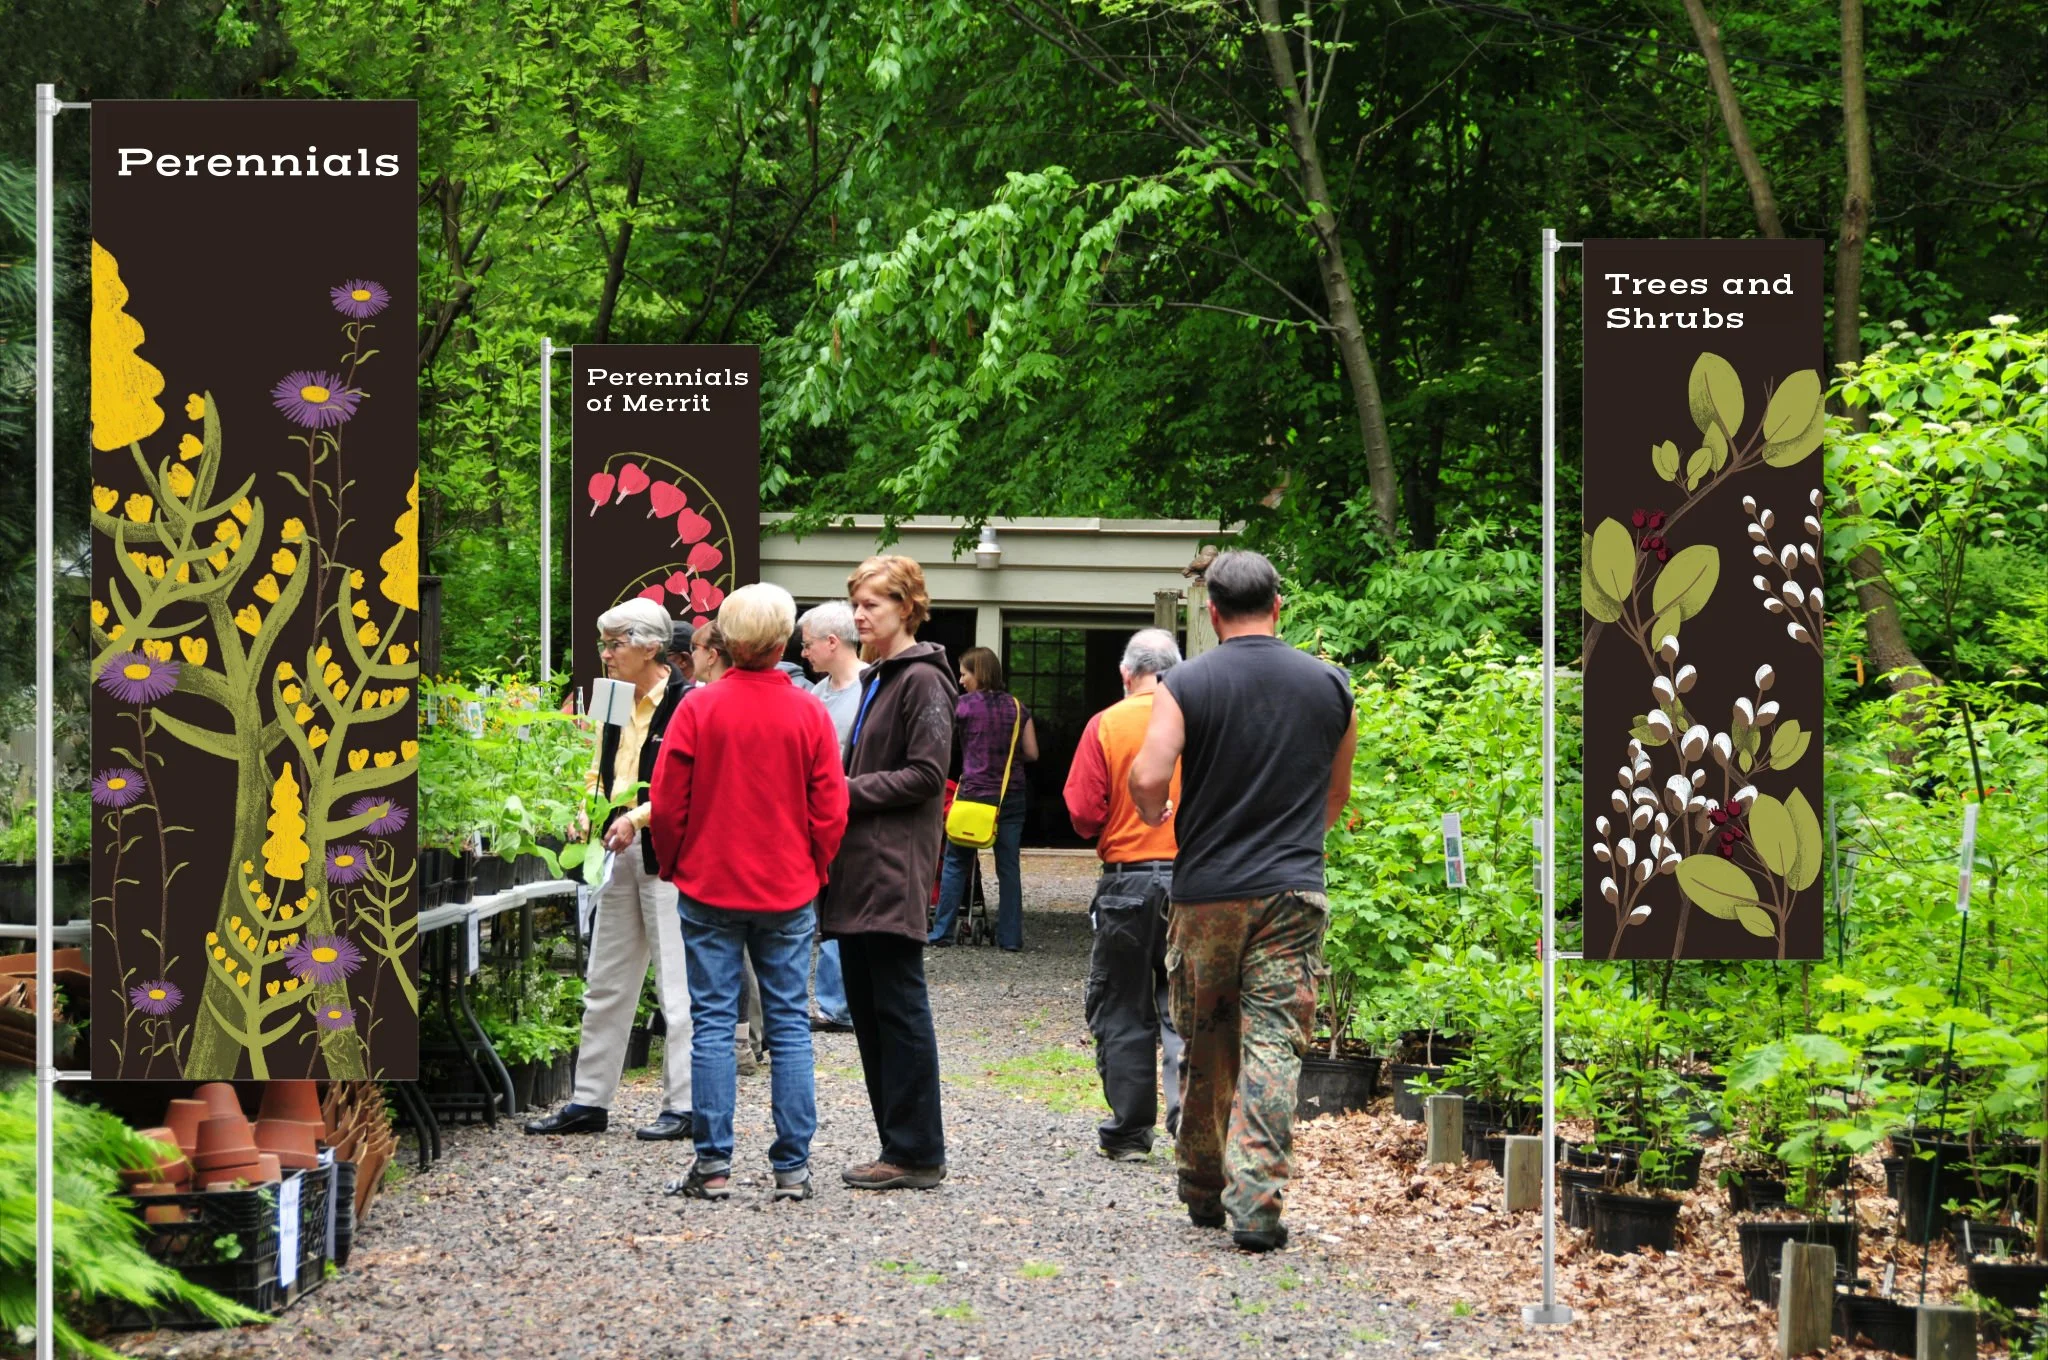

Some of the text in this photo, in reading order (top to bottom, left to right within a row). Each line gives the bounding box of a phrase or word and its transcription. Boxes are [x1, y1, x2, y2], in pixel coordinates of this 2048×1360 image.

[118, 145, 400, 177] Perennials
[1605, 273, 1794, 295] Trees and
[1606, 307, 1744, 329] Shrubs
[587, 368, 749, 386] Perennials
[586, 393, 711, 412] of Merrit
